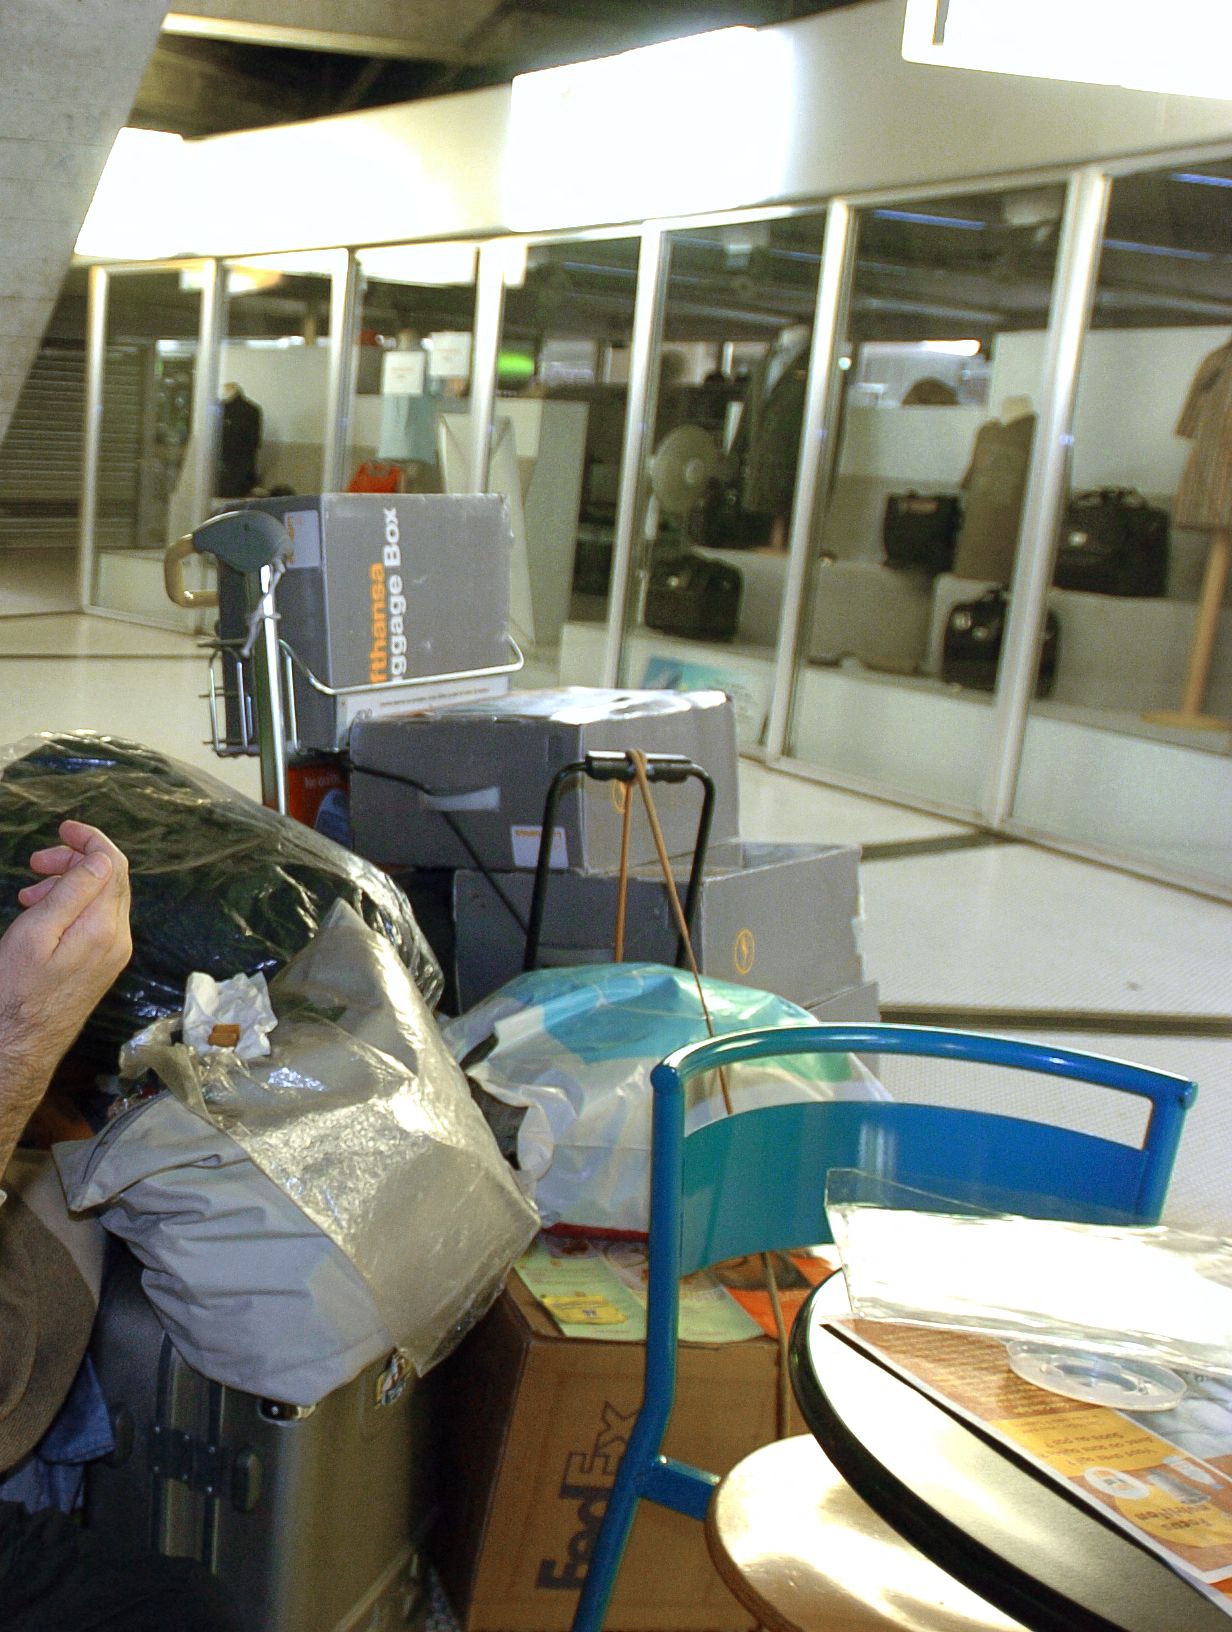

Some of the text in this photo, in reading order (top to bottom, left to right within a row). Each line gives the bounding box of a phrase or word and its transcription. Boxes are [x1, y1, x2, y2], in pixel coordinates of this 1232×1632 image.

[368, 562, 388, 682] fthansa
[382, 507, 408, 681] ggage Box
